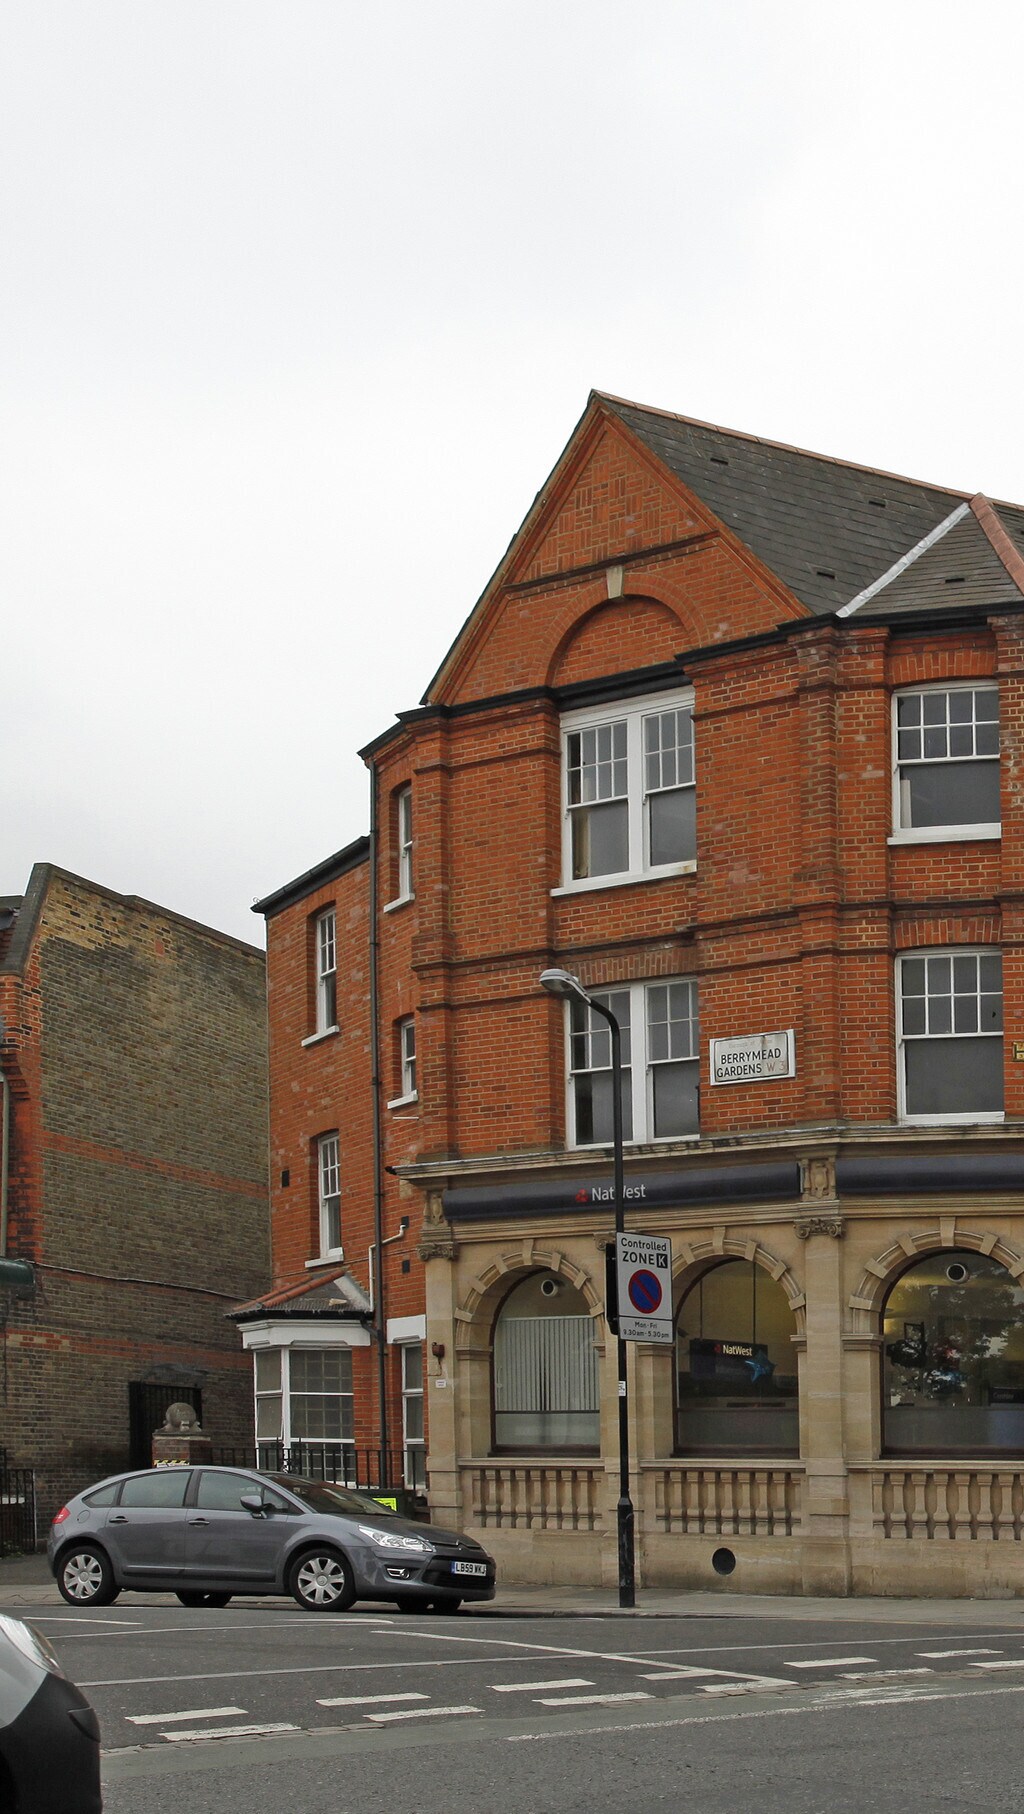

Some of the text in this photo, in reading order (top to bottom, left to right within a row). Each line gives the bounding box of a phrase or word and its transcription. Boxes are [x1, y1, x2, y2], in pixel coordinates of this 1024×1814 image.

[721, 1047, 782, 1065] BERRYMEAD
[716, 1060, 785, 1078] GARDENS W 3
[591, 1184, 646, 1201] Natest
[621, 1237, 667, 1252] Controlled
[622, 1251, 667, 1268] ZONE K
[722, 1345, 753, 1356] NatWest
[455, 1562, 473, 1573] LB59
